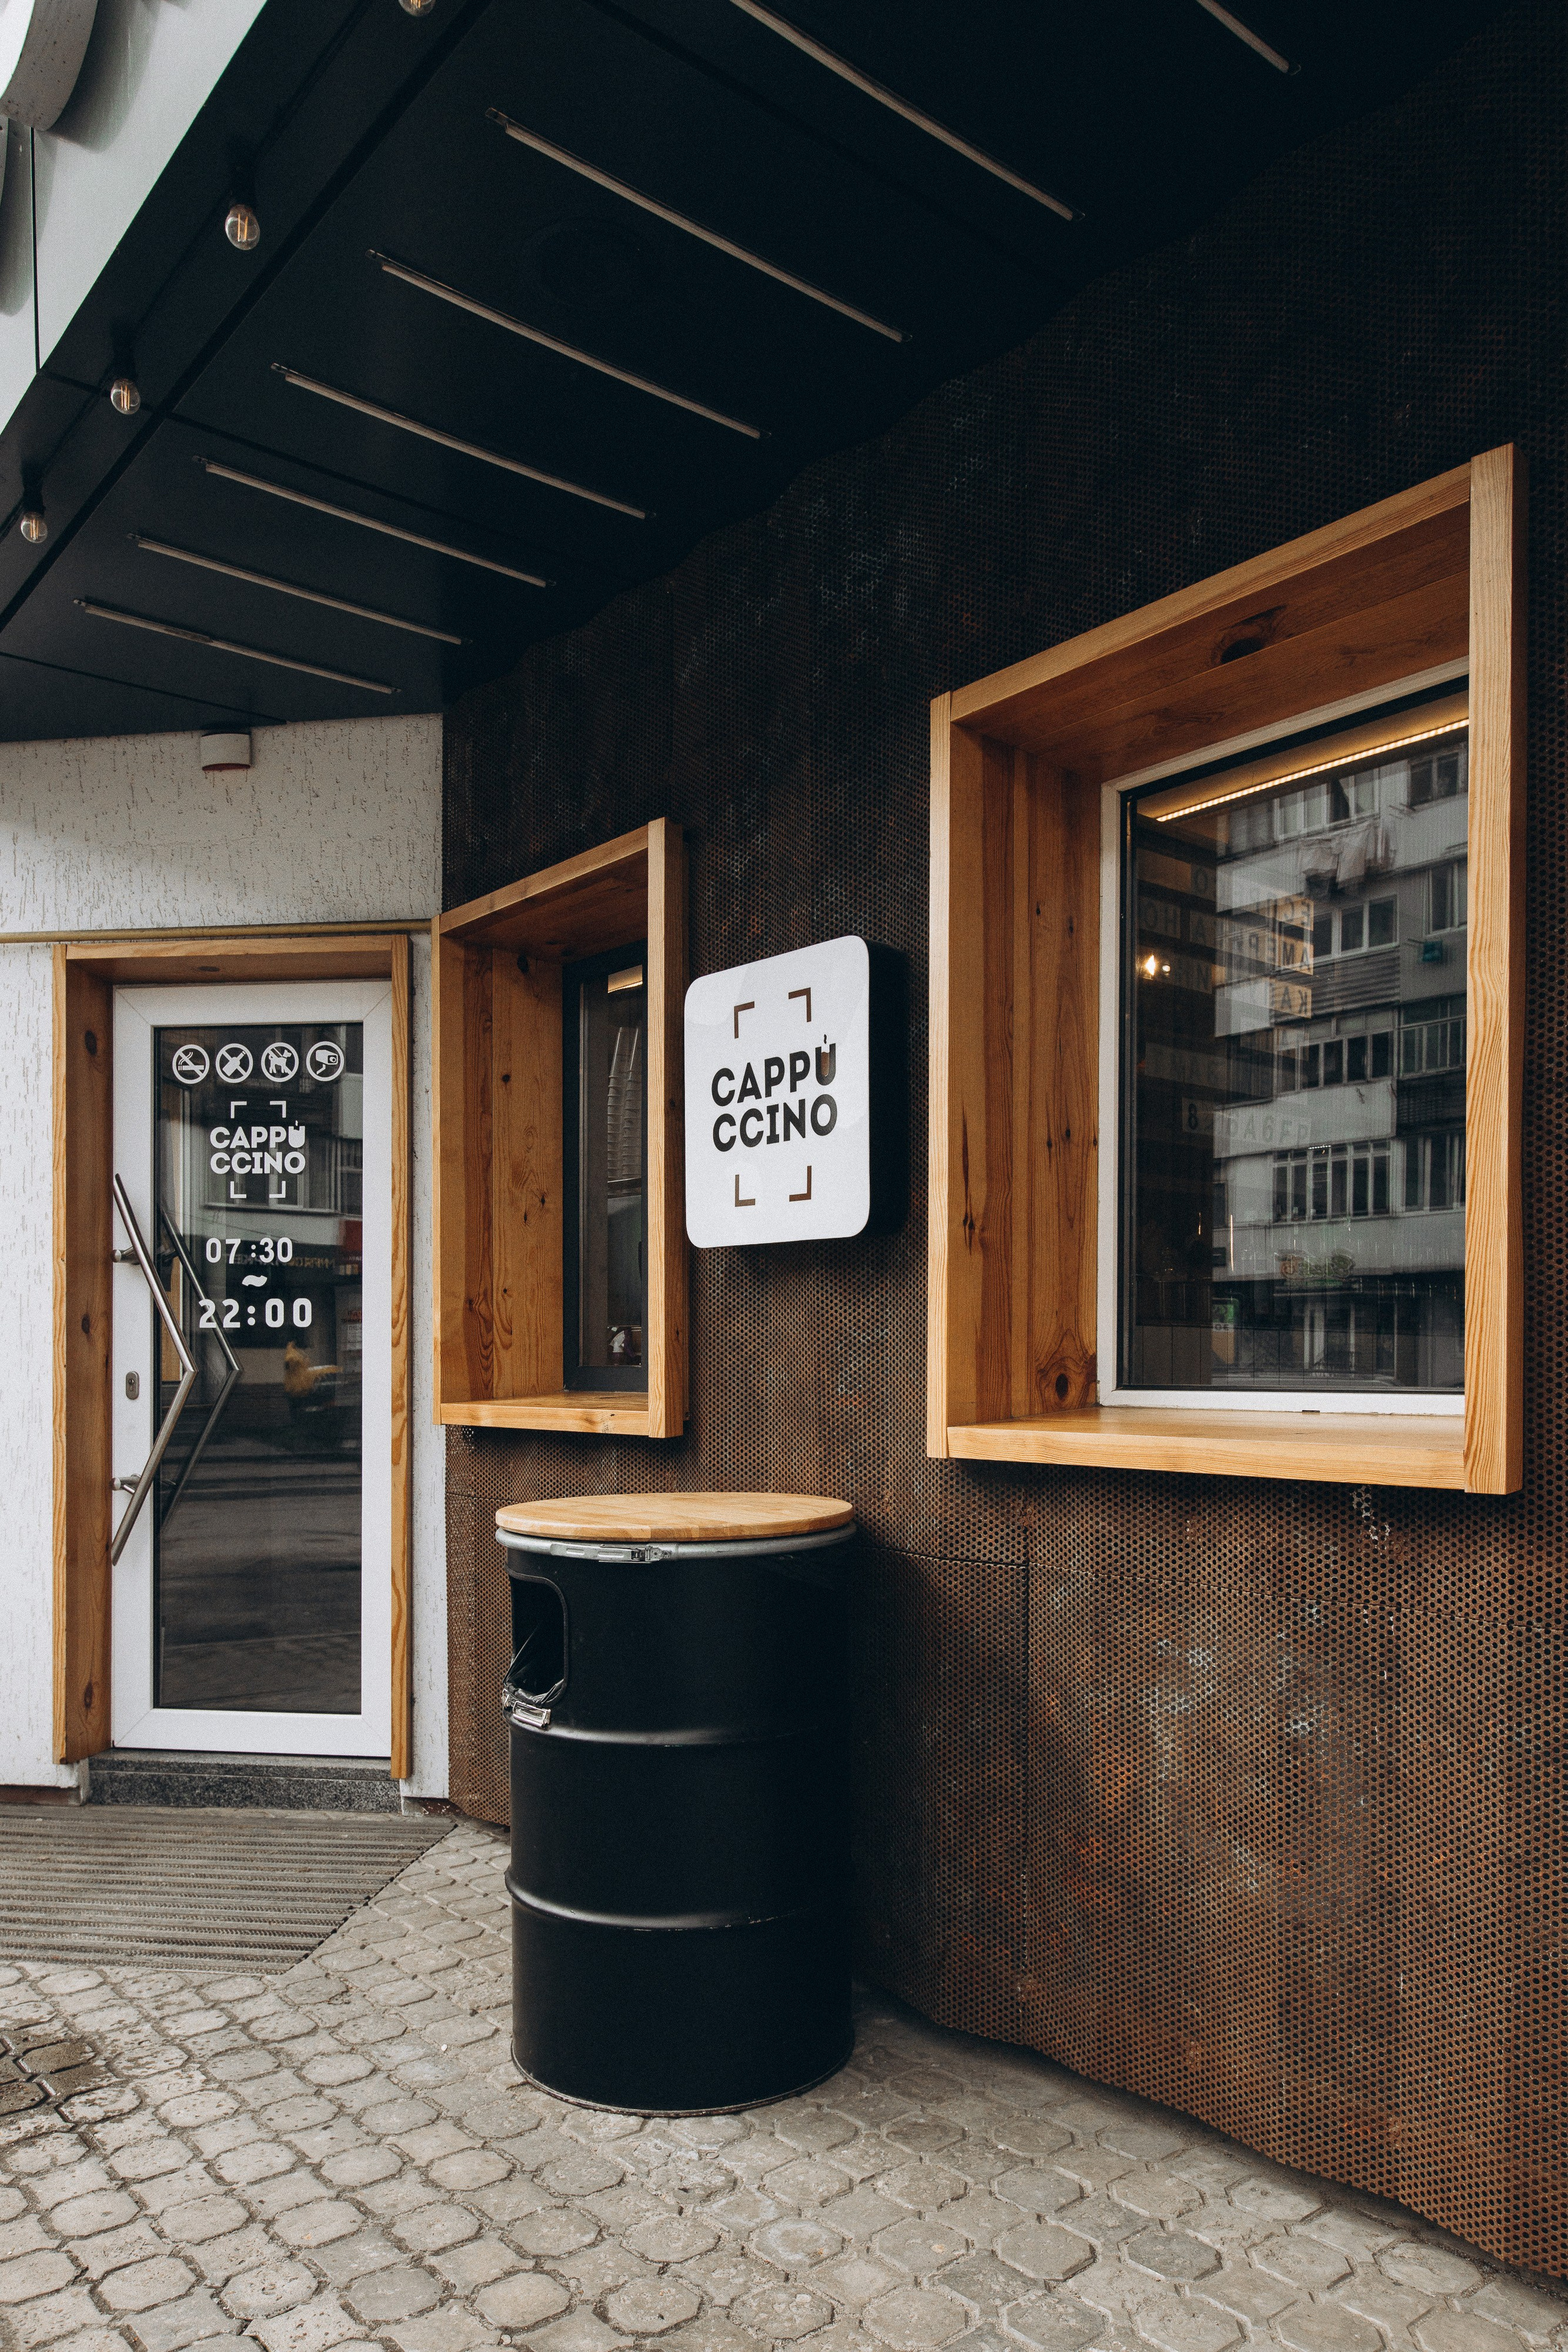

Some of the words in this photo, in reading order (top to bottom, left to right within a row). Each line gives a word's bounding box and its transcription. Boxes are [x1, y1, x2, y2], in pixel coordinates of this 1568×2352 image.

[711, 1035, 837, 1107] CAPPU
[210, 1121, 306, 1148] CAPPU
[713, 1094, 837, 1152] CCINO
[210, 1152, 306, 1174] CCINO
[205, 1237, 293, 1264] 07:30
[198, 1298, 312, 1328] 22:00
